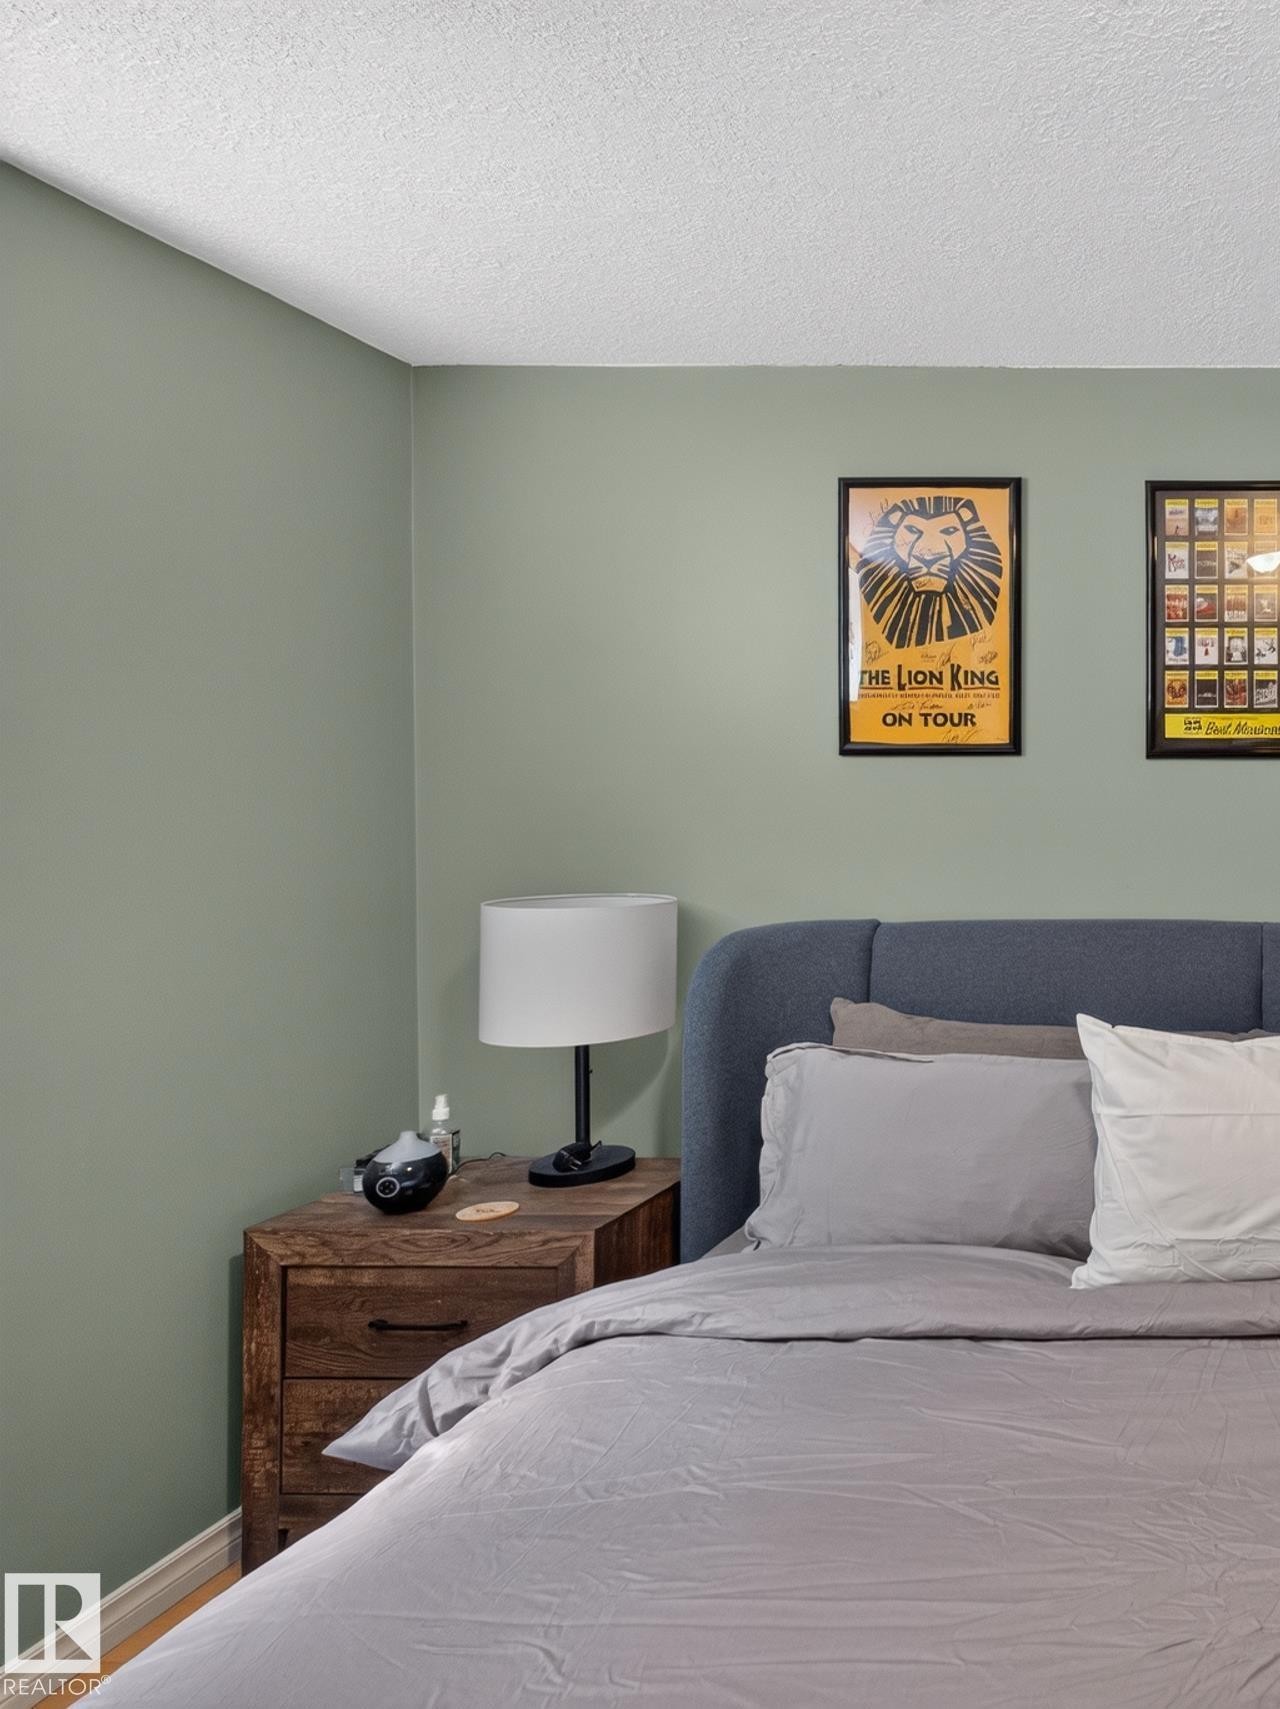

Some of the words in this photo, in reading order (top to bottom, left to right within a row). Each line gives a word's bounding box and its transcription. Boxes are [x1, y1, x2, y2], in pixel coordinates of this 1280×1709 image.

[859, 669, 891, 686] THE
[897, 664, 944, 691] LION
[950, 663, 999, 691] KING
[881, 712, 913, 728] ON
[918, 712, 977, 728] TOUR
